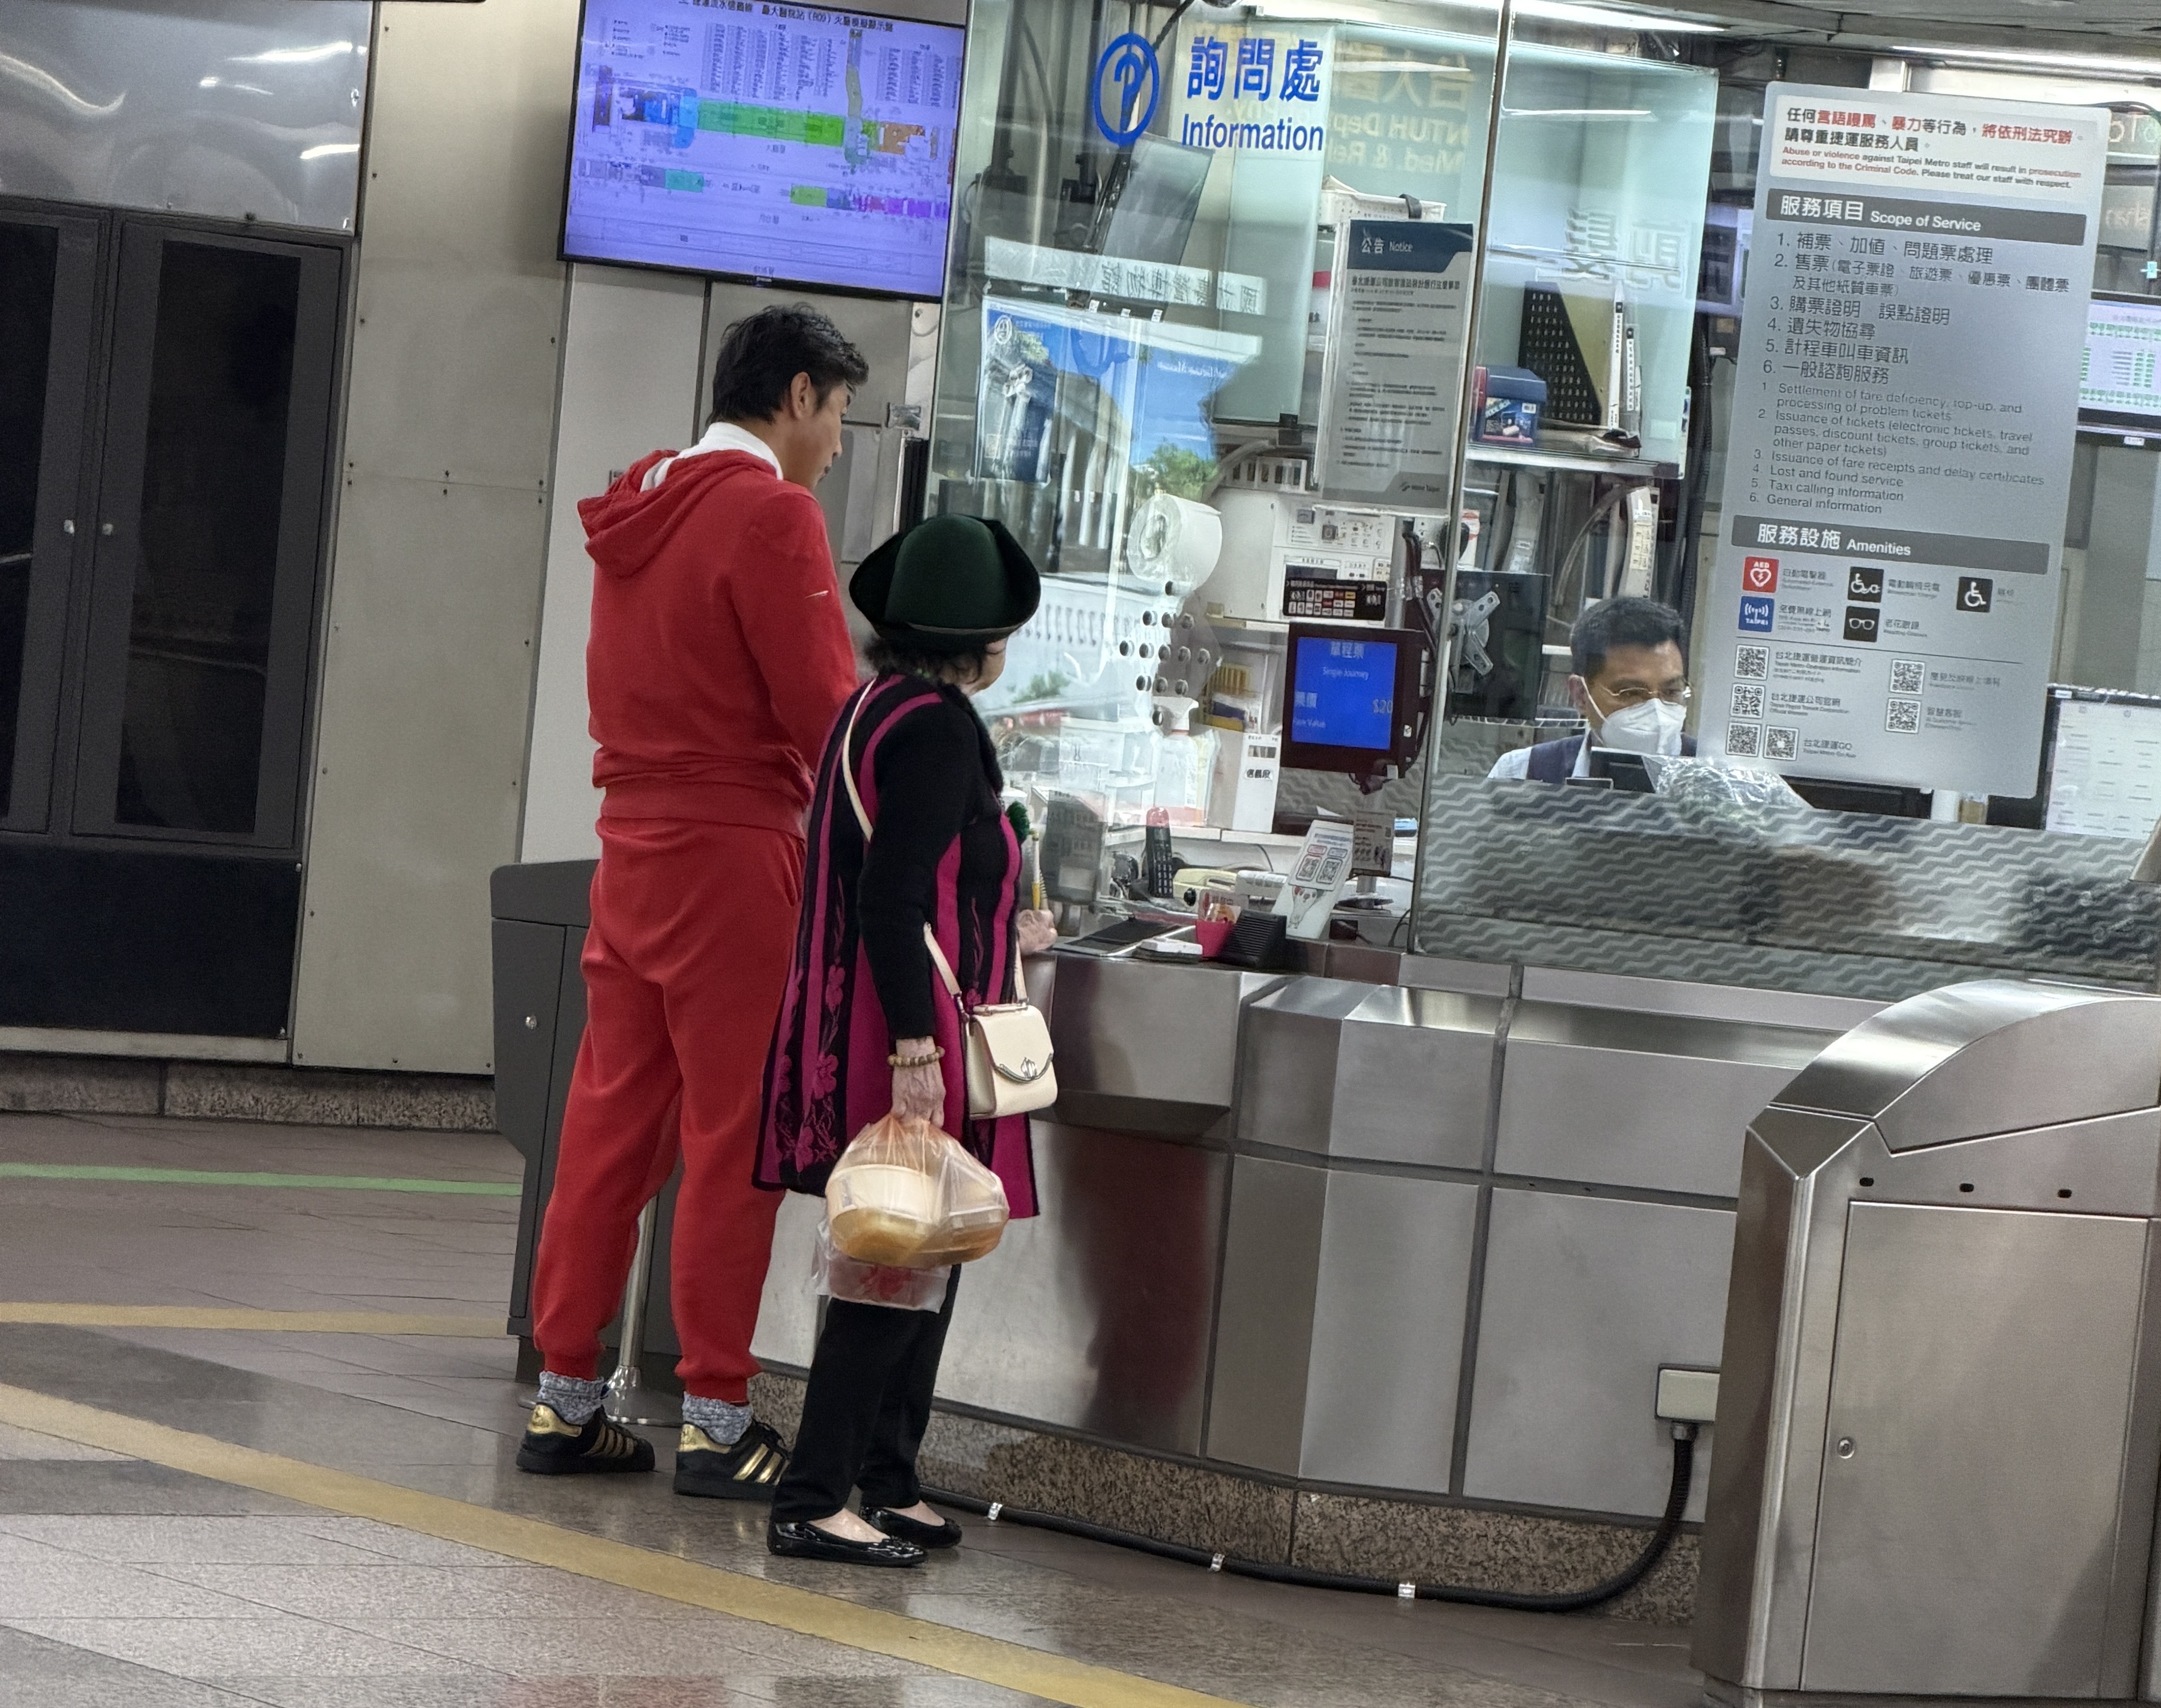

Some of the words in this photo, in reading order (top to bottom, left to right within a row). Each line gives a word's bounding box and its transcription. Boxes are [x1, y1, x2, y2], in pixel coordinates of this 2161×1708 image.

[1187, 36, 1323, 102] 詢問處
[1182, 114, 1323, 151] Information
[1783, 146, 1810, 157] Abuse
[1824, 149, 1859, 160] violence
[1862, 153, 1895, 163] against
[1898, 155, 1922, 166] Taipei
[1925, 158, 1950, 167] Metro
[1952, 161, 1973, 169] staff
[1782, 158, 1825, 169] according
[1827, 160, 1836, 168] to
[1839, 162, 1852, 170] the
[1855, 163, 1891, 173] Criminal
[1894, 166, 1919, 176] Code.
[1922, 168, 1951, 179] Please
[1953, 172, 1974, 180] treat
[1780, 195, 1864, 221] 服務項目
[1870, 210, 1912, 226] Scope
[1915, 215, 1929, 227] of
[1932, 216, 1981, 231] Service
[1361, 237, 1384, 254] 公告
[1778, 232, 1790, 247] 1.
[1774, 253, 1788, 267] 2.
[1770, 295, 1783, 310] 3.
[1767, 317, 1781, 331] 4.
[1787, 316, 1876, 340] 遺失物協尋
[1766, 339, 1778, 353] 5.
[1785, 338, 1909, 365] 計程車叫車資訊
[1763, 359, 1776, 374] 6.
[1782, 360, 1890, 385] 一般諮詢服務
[1777, 398, 1842, 413] processing
[1845, 403, 1856, 412] of
[1860, 405, 1909, 416] problem
[1779, 383, 1841, 398] Settlement
[1845, 390, 1856, 399] of
[1861, 391, 1882, 401] fare
[1999, 402, 2022, 413] and
[1775, 410, 1828, 424] Issuance
[1831, 415, 1843, 425] of
[1847, 416, 1885, 429] tickets
[1773, 437, 1803, 448] other
[1806, 441, 1841, 452] paper
[1844, 444, 1887, 458] tickets)
[1822, 428, 1873, 441] discount
[1922, 438, 1957, 451] group
[1772, 451, 1824, 465] Issuance
[1827, 456, 1838, 466] of
[1843, 457, 1865, 468] fare
[1868, 460, 1915, 473] receipts
[1918, 465, 1940, 475] and
[1770, 465, 1795, 477] Lost
[1799, 468, 1821, 479] and
[1824, 470, 1858, 482] found
[1862, 474, 1903, 487] service
[1769, 479, 1792, 492] Taxi
[1796, 483, 1834, 497] calling
[1838, 487, 1903, 502] information
[1767, 494, 1812, 508] General
[1815, 499, 1882, 514] information
[1757, 523, 1842, 550] 服務設施
[1846, 538, 1911, 556] Amenities
